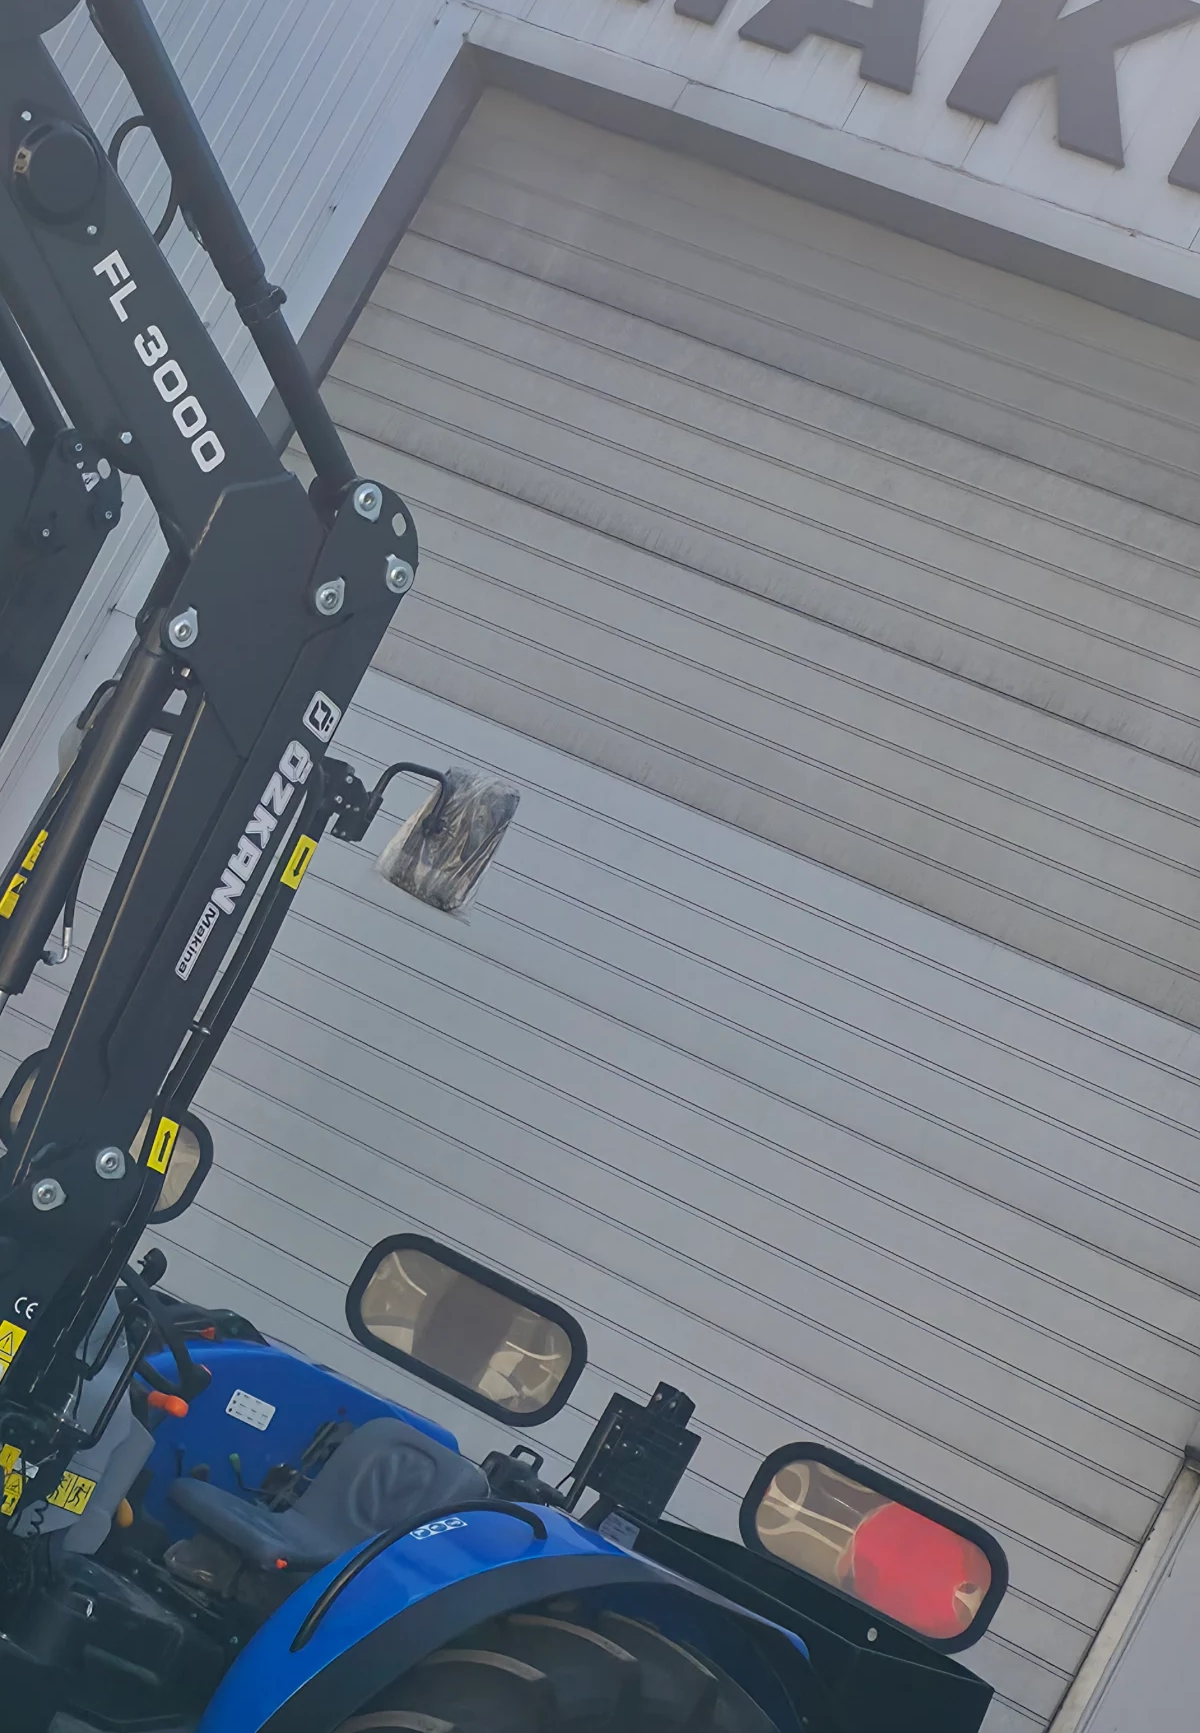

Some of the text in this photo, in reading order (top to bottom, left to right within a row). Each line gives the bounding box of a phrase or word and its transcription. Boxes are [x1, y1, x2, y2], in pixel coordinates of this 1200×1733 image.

[93, 249, 225, 473] FL 3000
[211, 740, 313, 915] ÖZKAN
[177, 907, 217, 974] Makina
